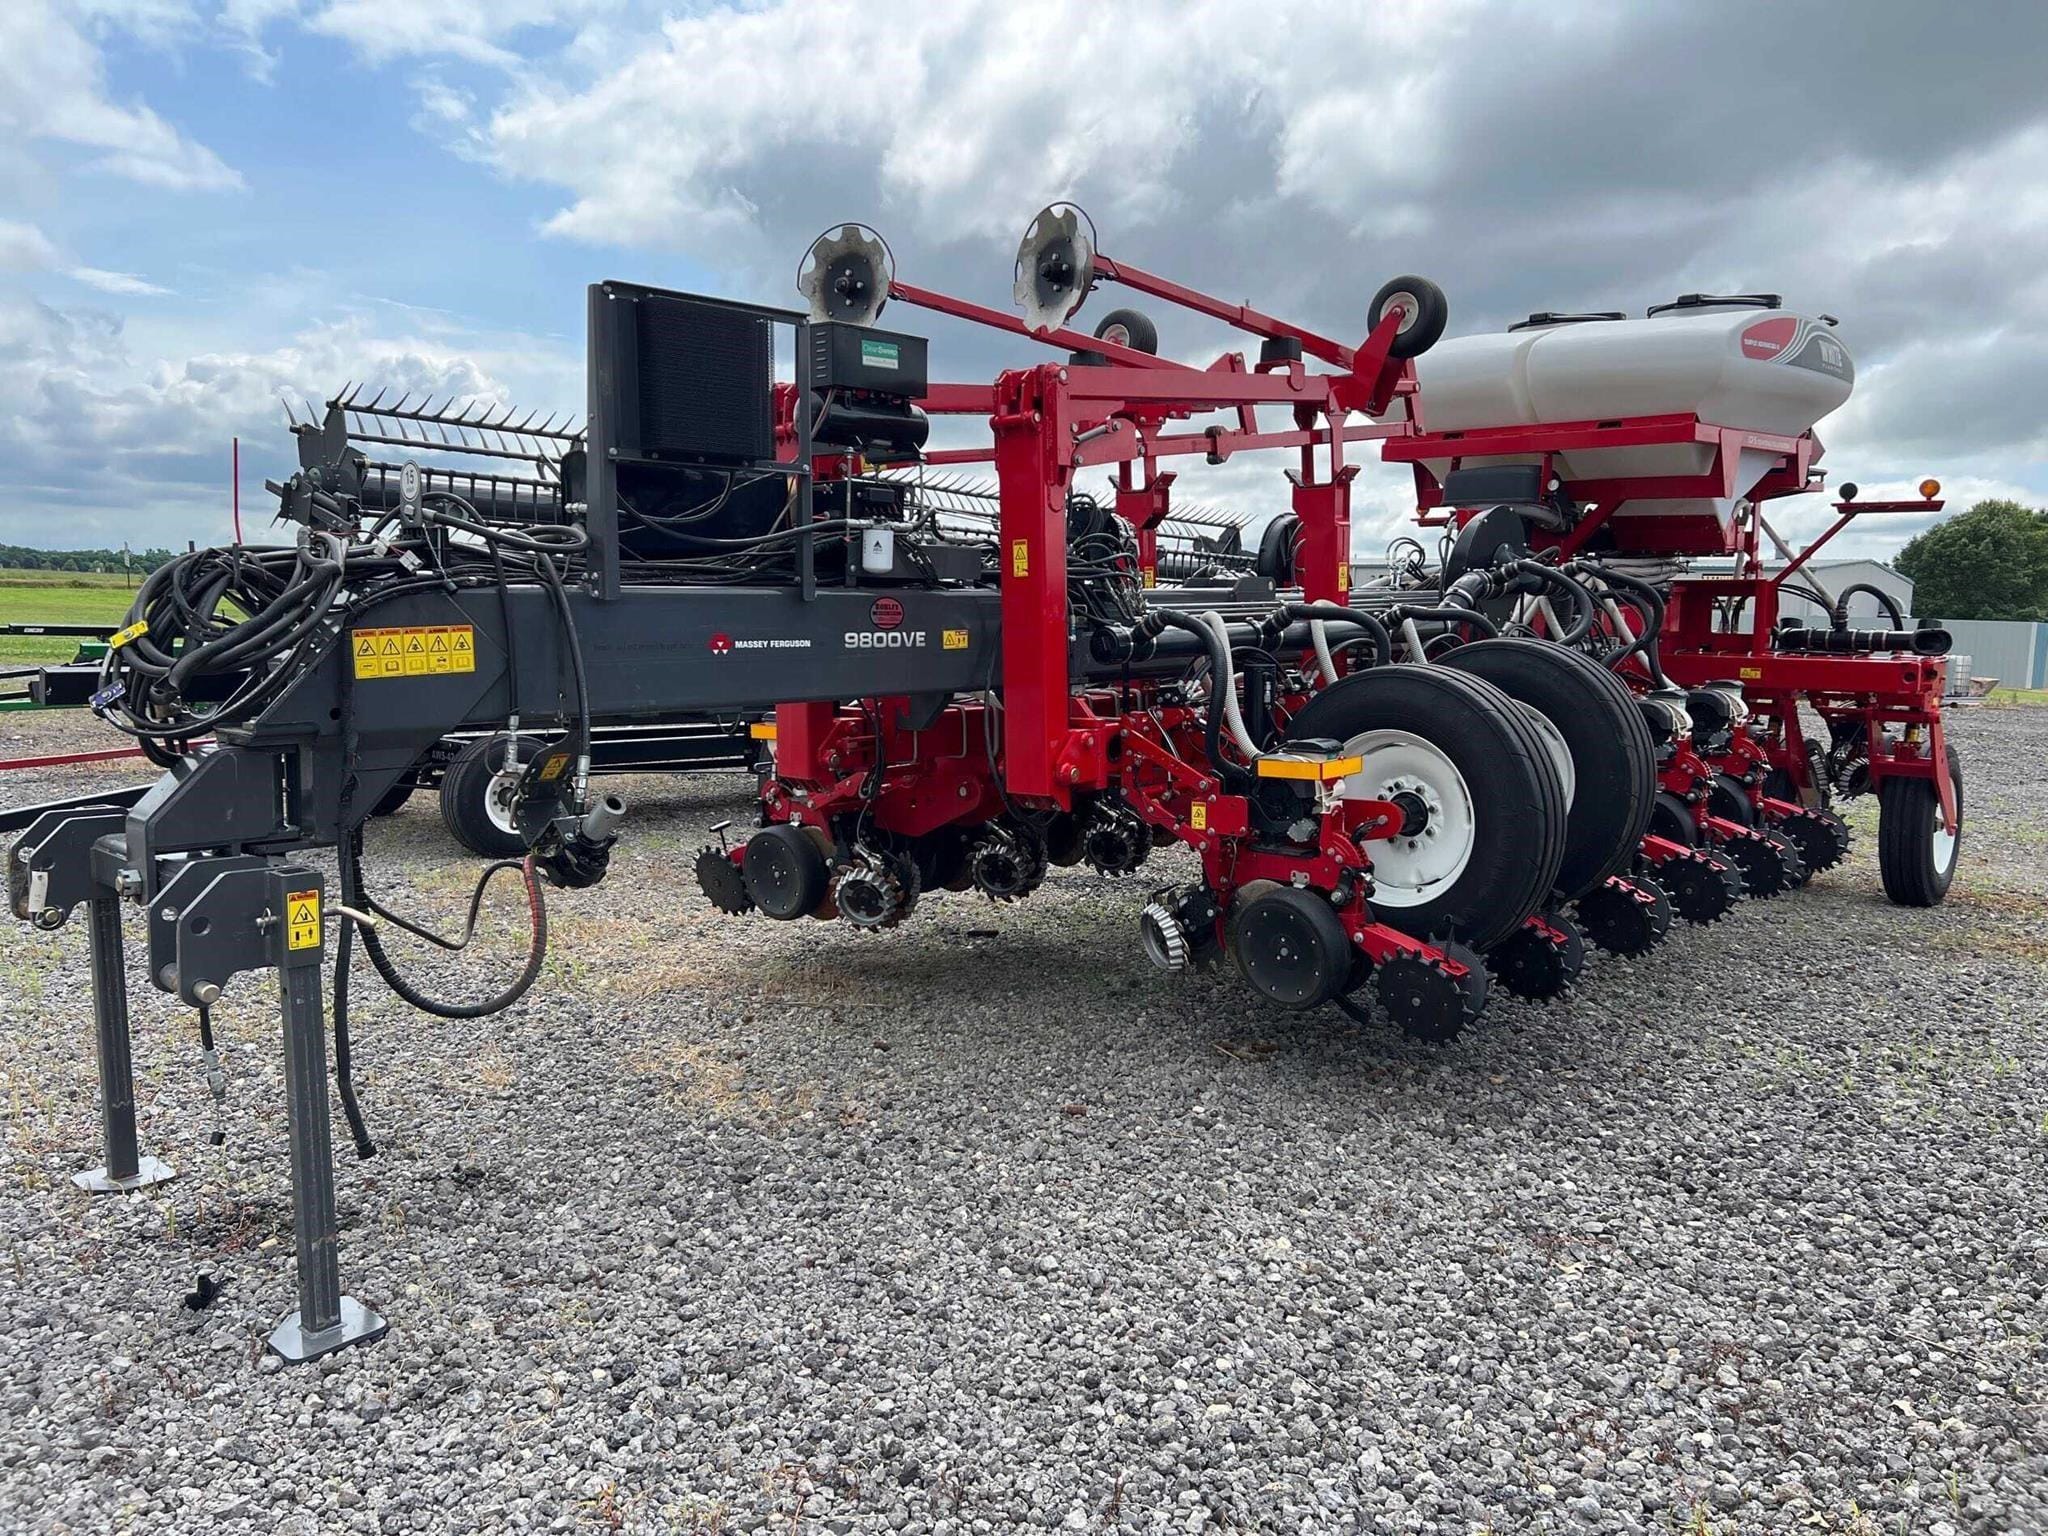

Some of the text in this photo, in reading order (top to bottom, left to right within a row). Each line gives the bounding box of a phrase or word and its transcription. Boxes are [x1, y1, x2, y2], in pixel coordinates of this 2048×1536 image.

[406, 469, 414, 484] 15
[735, 639, 811, 649] MASSEY FERGUSON
[845, 631, 926, 648] 9800VE
